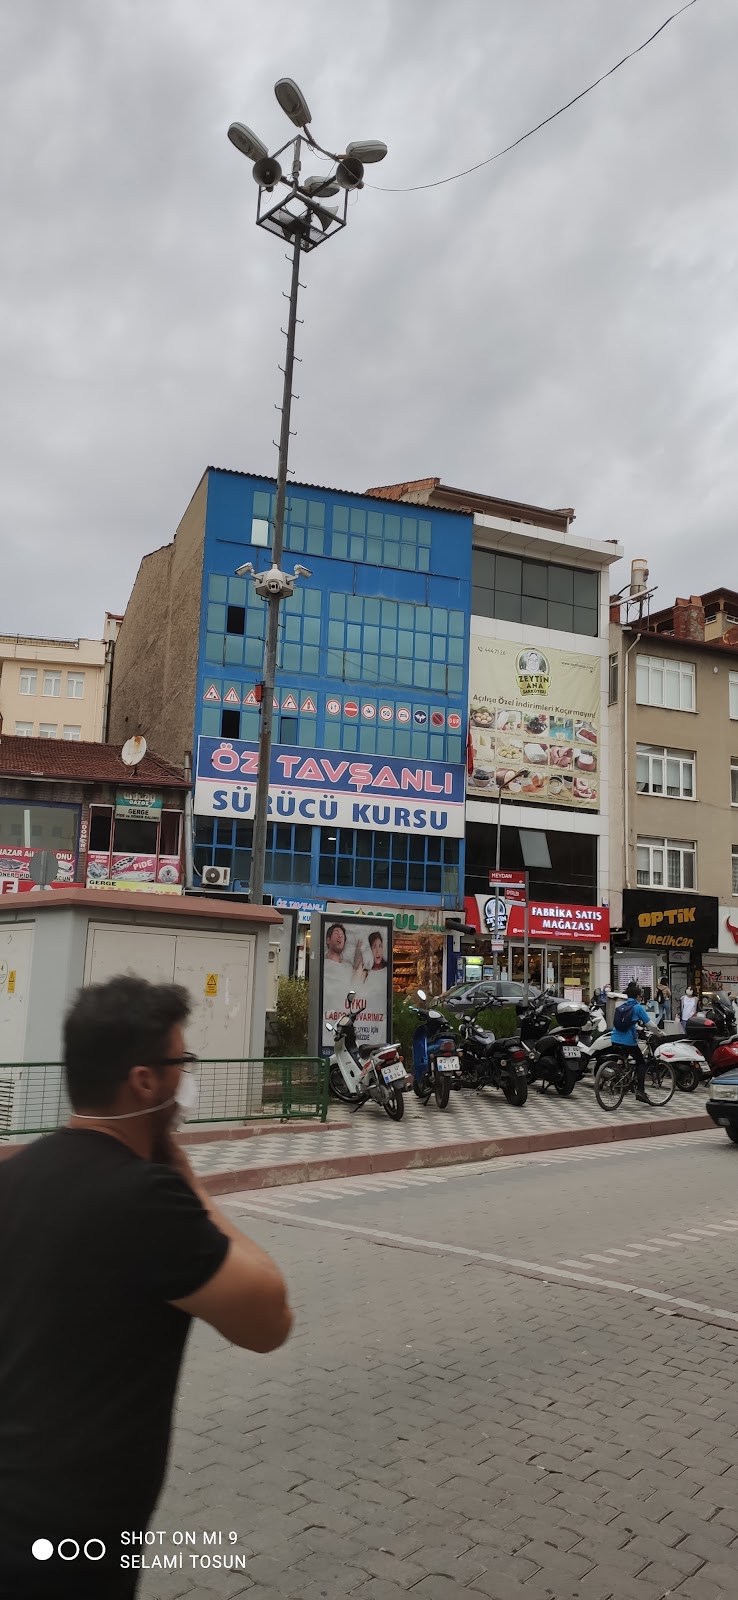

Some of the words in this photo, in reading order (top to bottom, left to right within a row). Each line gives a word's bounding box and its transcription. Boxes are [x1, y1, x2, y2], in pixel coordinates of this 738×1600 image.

[498, 696, 514, 706] Özel
[211, 742, 259, 775] ÖZ
[276, 754, 452, 794] TAVŞANLI
[353, 803, 448, 830] KURSU
[277, 898, 287, 907] ÖZ
[289, 901, 324, 911] TAVŞANLI
[532, 907, 572, 918] FABRİKA
[576, 911, 602, 921] SATIŞ
[542, 919, 594, 931] MAĞAZASI
[345, 999, 366, 1009] UYKU
